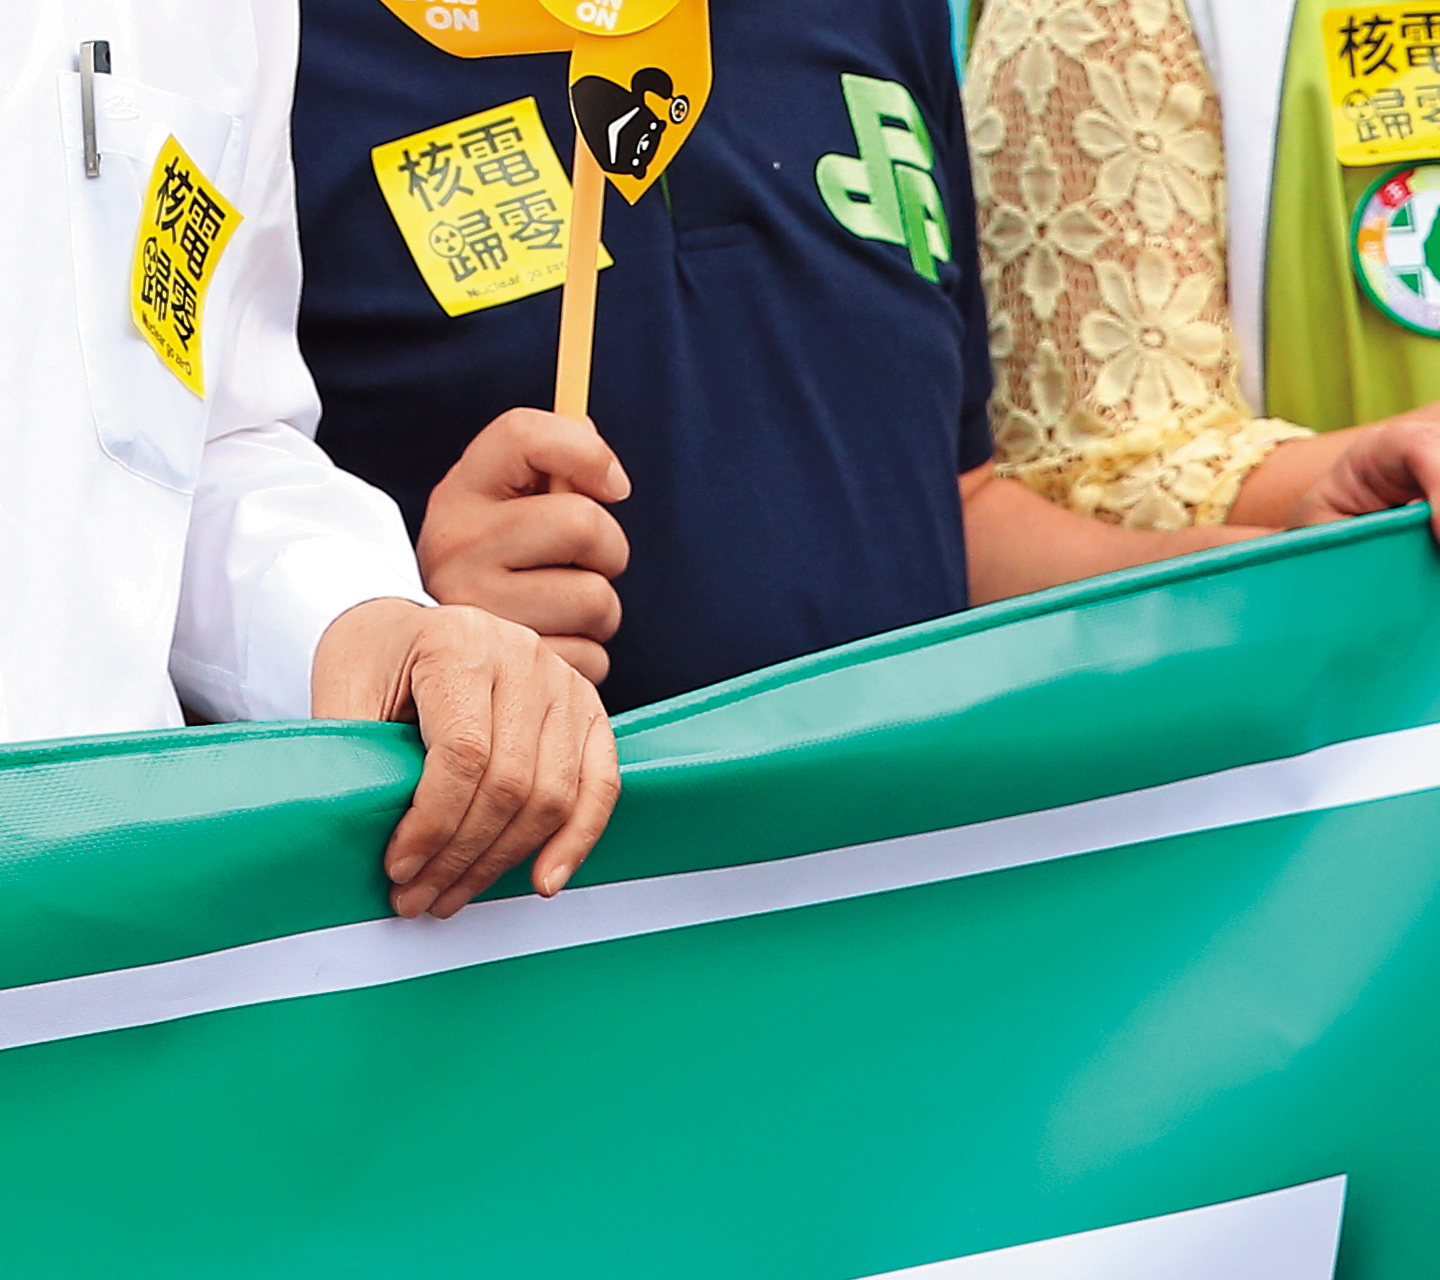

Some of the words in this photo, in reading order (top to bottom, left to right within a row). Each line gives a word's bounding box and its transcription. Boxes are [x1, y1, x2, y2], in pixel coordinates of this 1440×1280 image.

[424, 6, 479, 32] NO
[575, 1, 619, 31] NO
[397, 115, 540, 213] 核電
[156, 155, 227, 282] 核電
[428, 189, 565, 283] 歸零
[141, 236, 198, 353] 歸零
